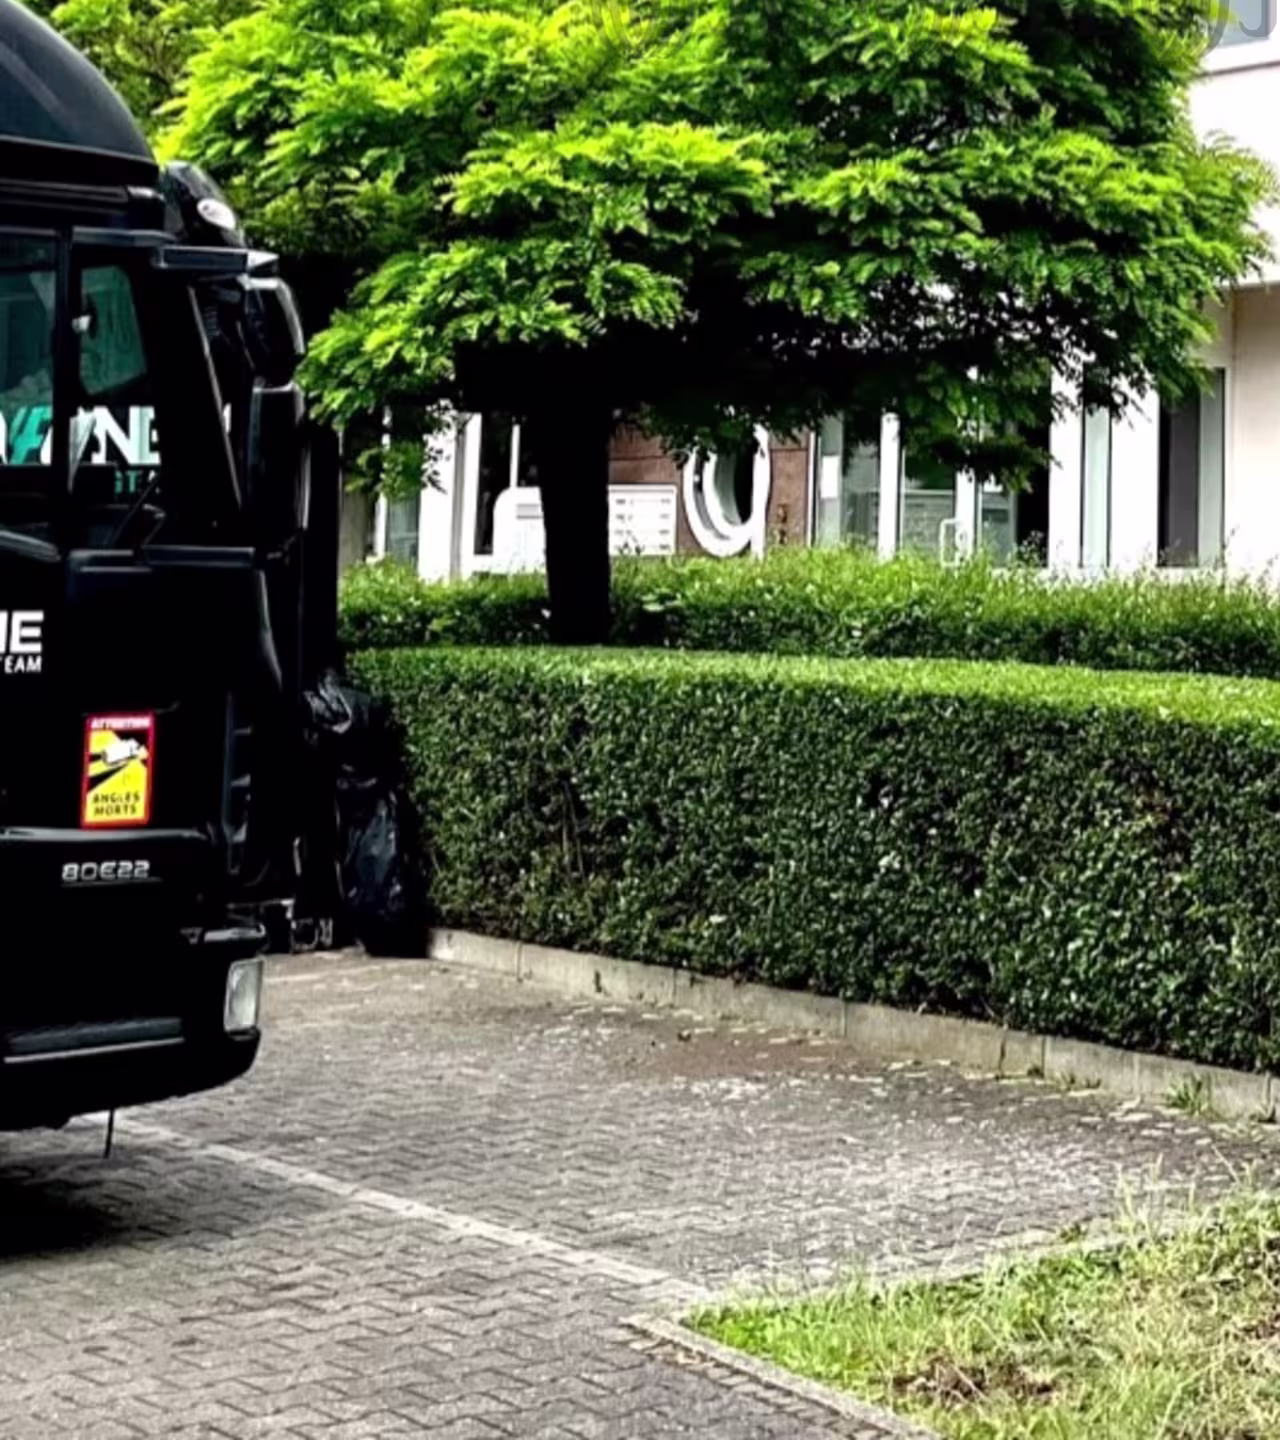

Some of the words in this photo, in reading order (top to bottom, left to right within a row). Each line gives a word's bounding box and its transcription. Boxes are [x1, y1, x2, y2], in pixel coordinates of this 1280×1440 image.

[0, 655, 43, 674] EAM
[92, 789, 141, 804] ANGLES
[93, 803, 137, 817] MORTS
